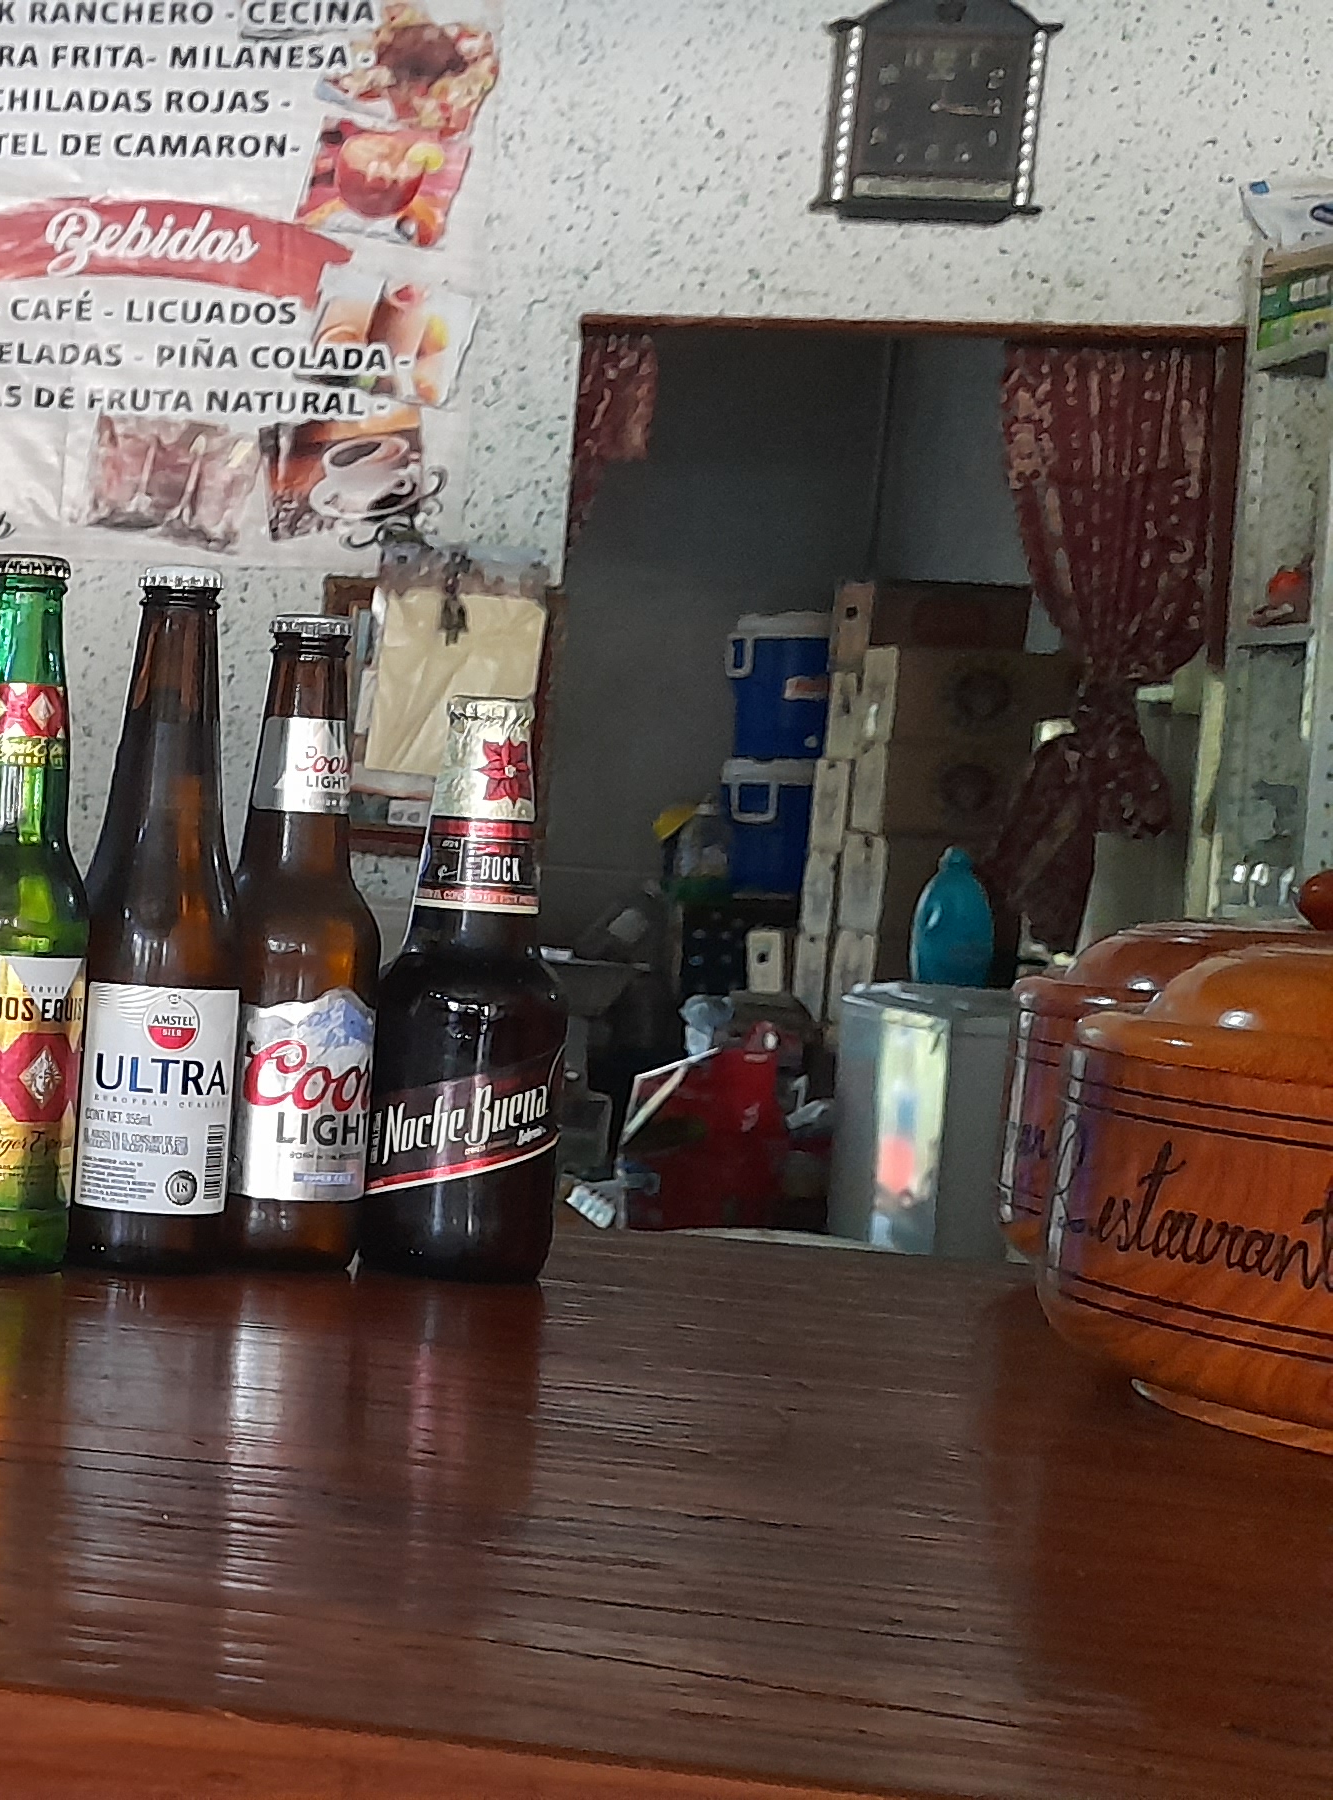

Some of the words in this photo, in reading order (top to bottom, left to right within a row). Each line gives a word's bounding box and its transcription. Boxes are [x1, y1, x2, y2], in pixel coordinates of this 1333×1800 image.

[31, 1, 213, 25] RANCHERO
[247, 1, 376, 26] CECINA
[169, 45, 349, 69] MILANESA
[164, 89, 270, 114] ROJAS
[60, 133, 101, 158] DE
[46, 206, 260, 277] Bebidas
[11, 290, 93, 323] CAFÉ
[126, 299, 297, 326] LICUADOS
[156, 338, 238, 369] PIÑA
[250, 344, 387, 371] COLADA
[35, 386, 75, 409] DE
[88, 387, 193, 413] FRUTA
[206, 388, 365, 415] NATURAL
[306, 775, 347, 790] LIGHT
[479, 855, 521, 882] BOCK
[151, 1015, 194, 1026] AMSTEL
[161, 1028, 183, 1037] BIER
[95, 1052, 227, 1096] ULTRA
[94, 1094, 168, 1107] EUROPEAN
[382, 1095, 466, 1165] Noche
[464, 1084, 549, 1146] Buena
[175, 1181, 189, 1194] 18
